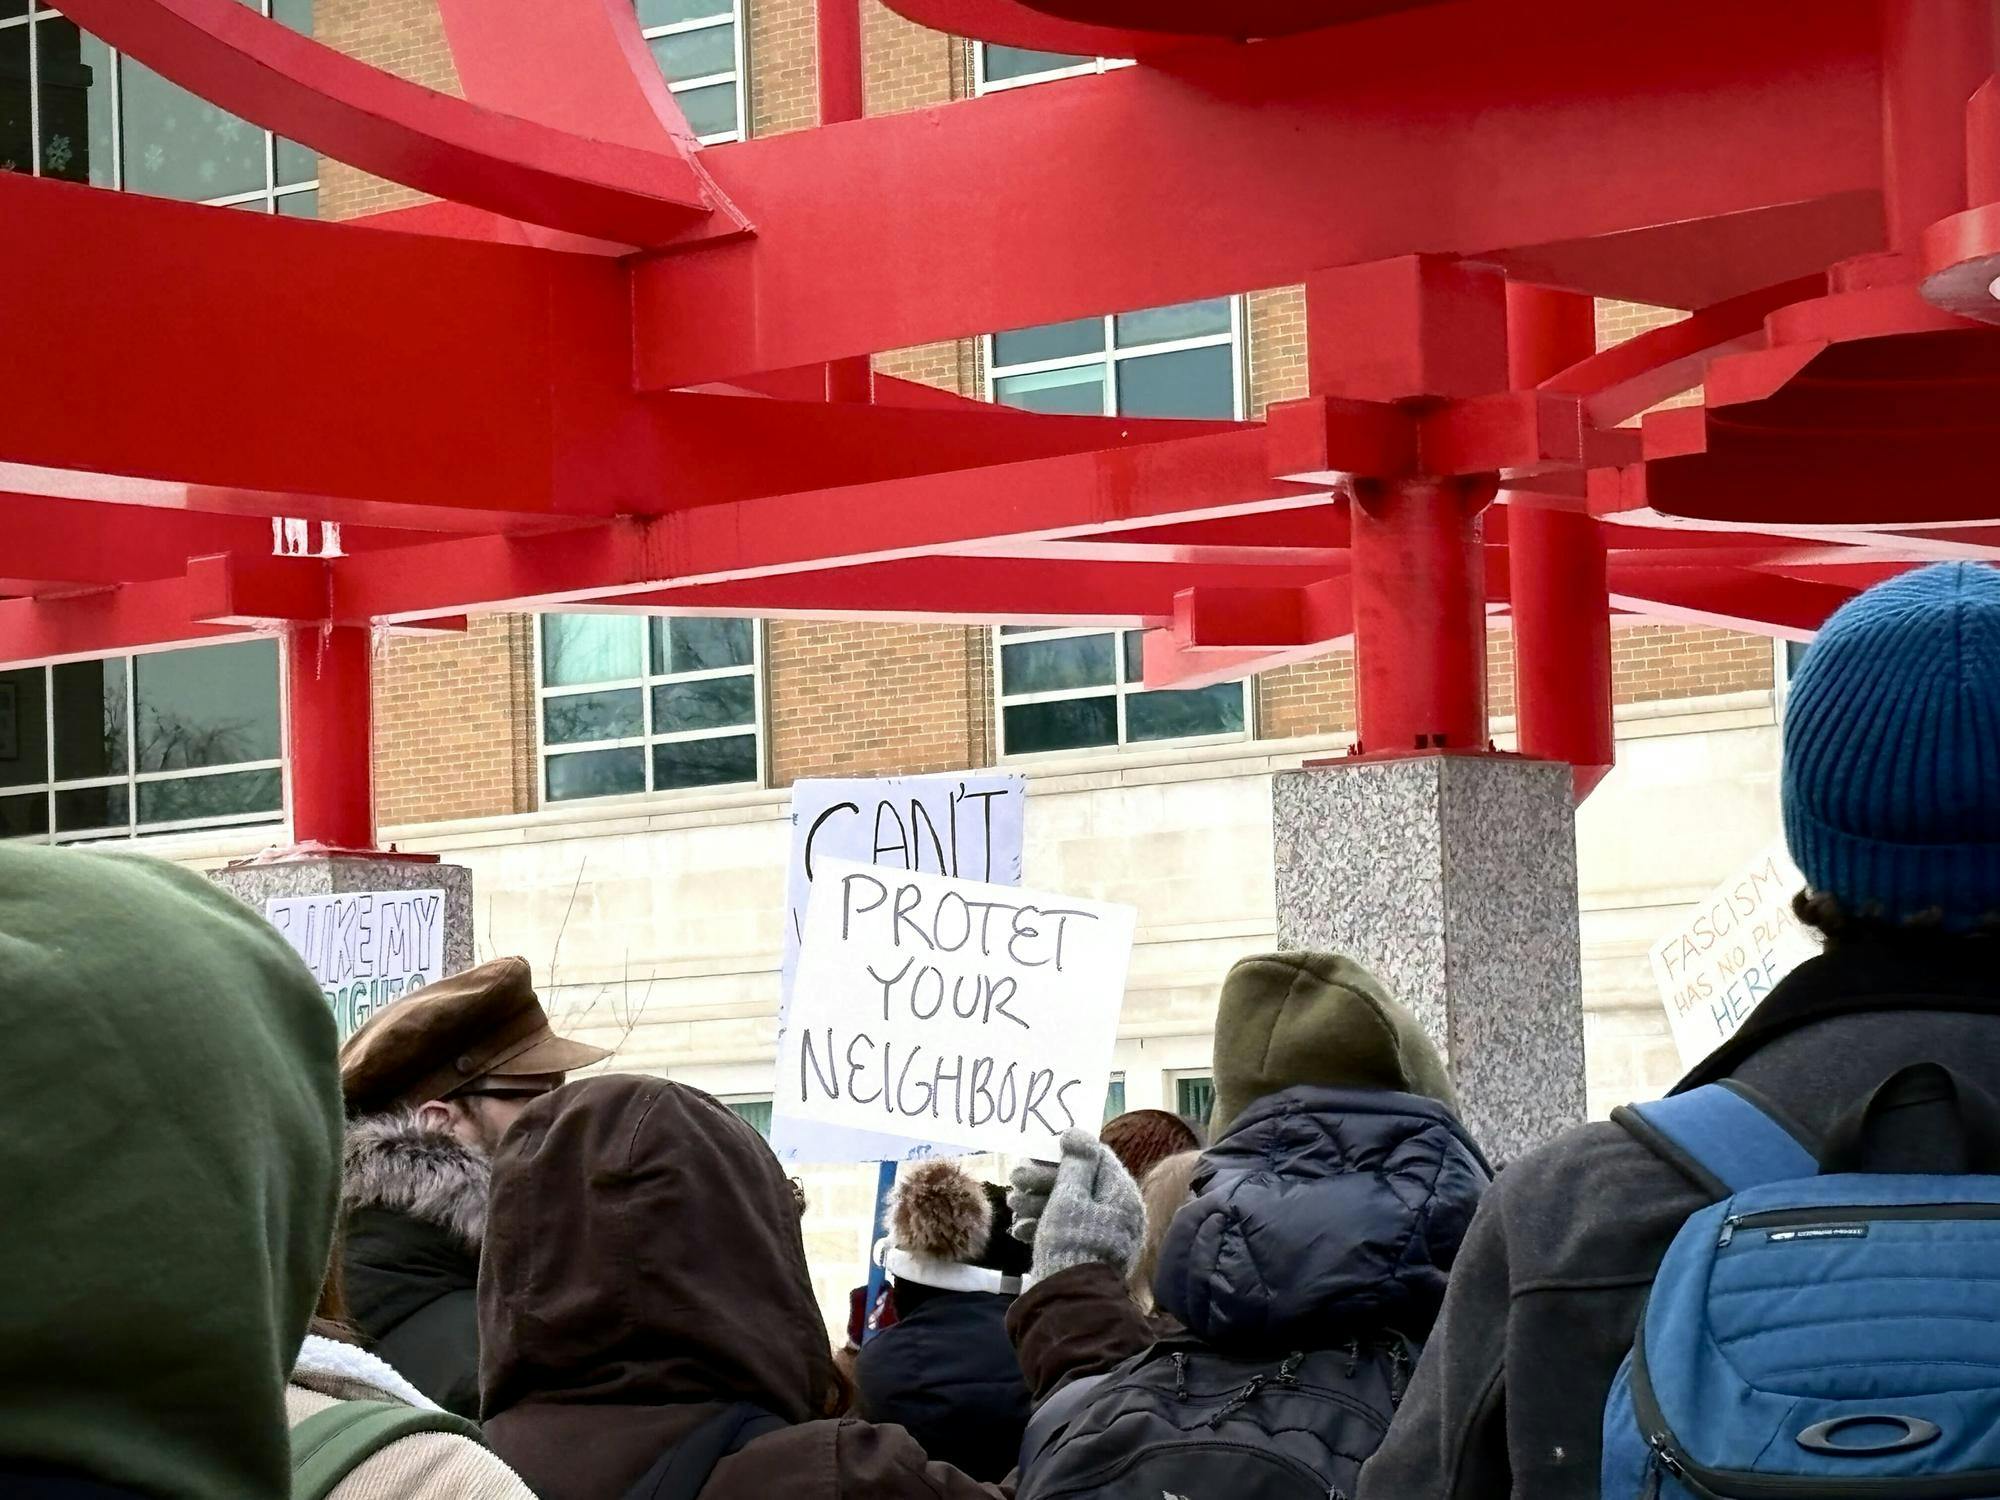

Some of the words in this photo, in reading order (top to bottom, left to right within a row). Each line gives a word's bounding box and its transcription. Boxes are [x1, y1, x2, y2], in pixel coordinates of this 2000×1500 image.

[805, 782, 1009, 883] CAN'T
[304, 895, 374, 986] LIKE
[379, 895, 440, 978] MY
[841, 873, 1099, 972] PROTET
[1661, 856, 1784, 981] FASCISM
[1673, 971, 1713, 1018] HAS
[1716, 945, 1746, 981] NO
[1751, 898, 1797, 953] PLA
[866, 956, 1030, 1029] YOUR
[801, 1028, 1083, 1137] NEIGHBORS
